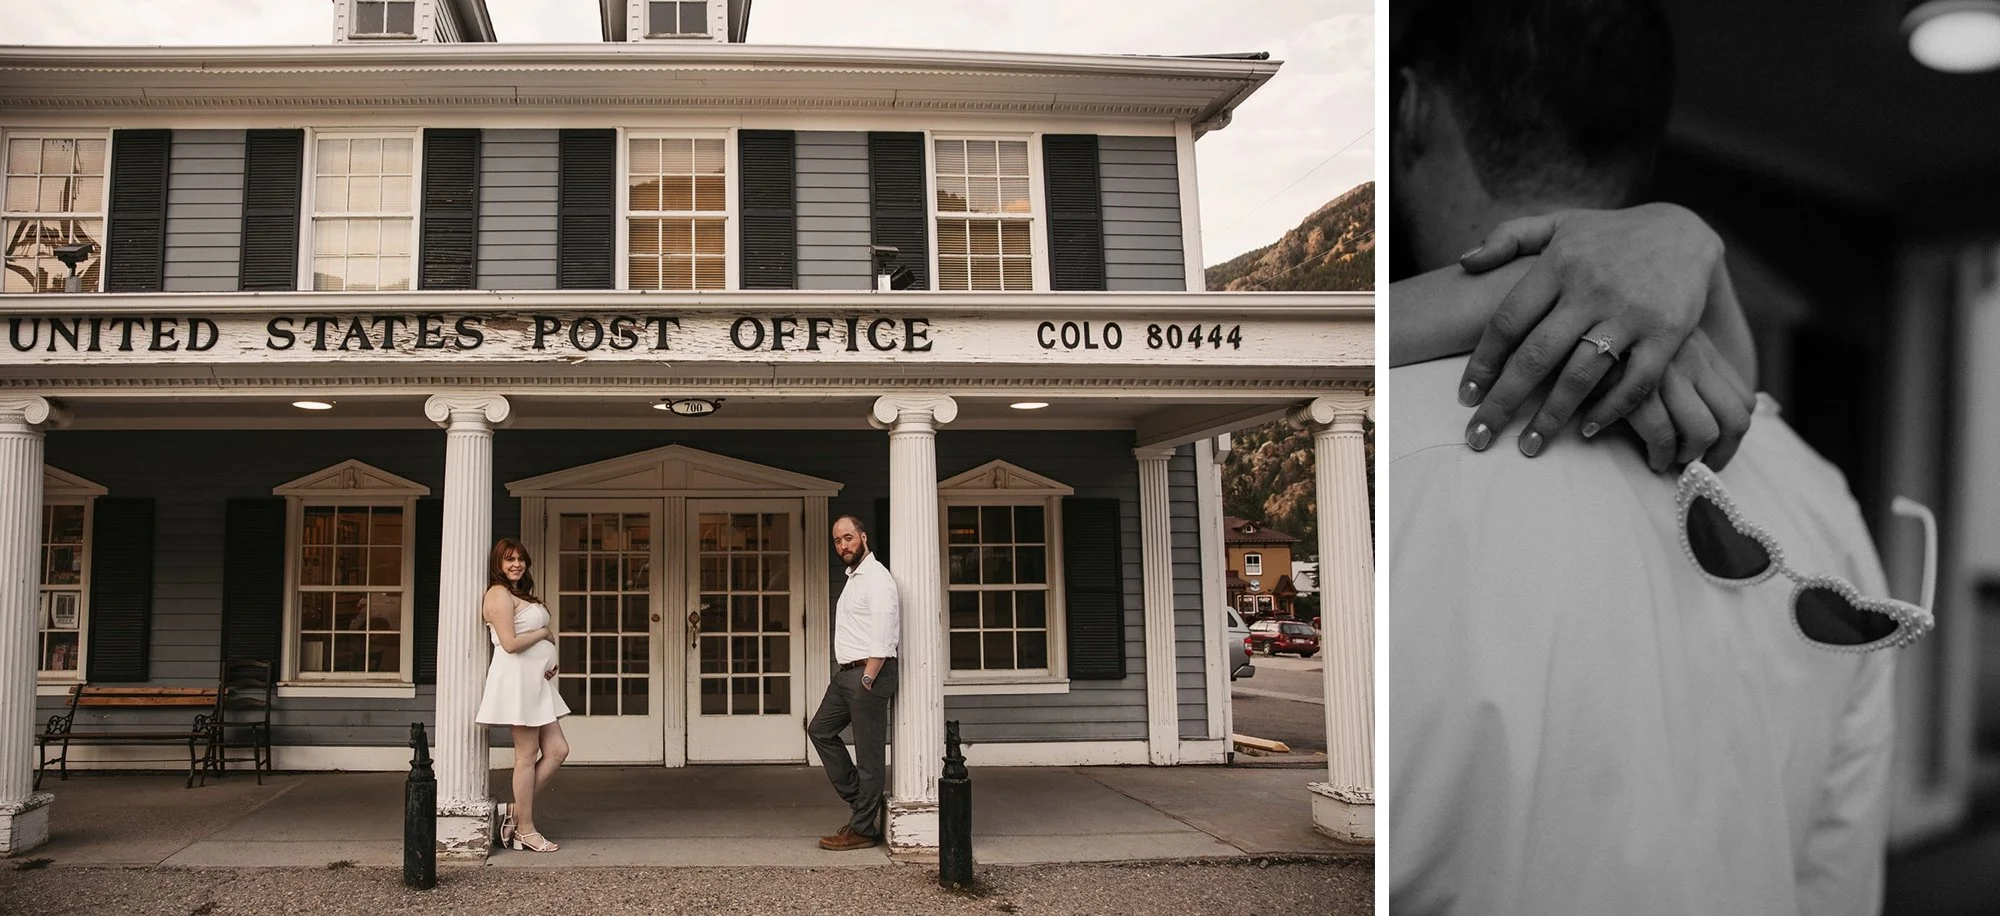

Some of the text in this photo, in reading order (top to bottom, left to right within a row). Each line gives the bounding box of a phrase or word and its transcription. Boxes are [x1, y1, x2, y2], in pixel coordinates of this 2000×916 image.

[9, 316, 1242, 352] UNITED STATES POST OFFICE COLO 80444
[684, 402, 703, 412] 700
